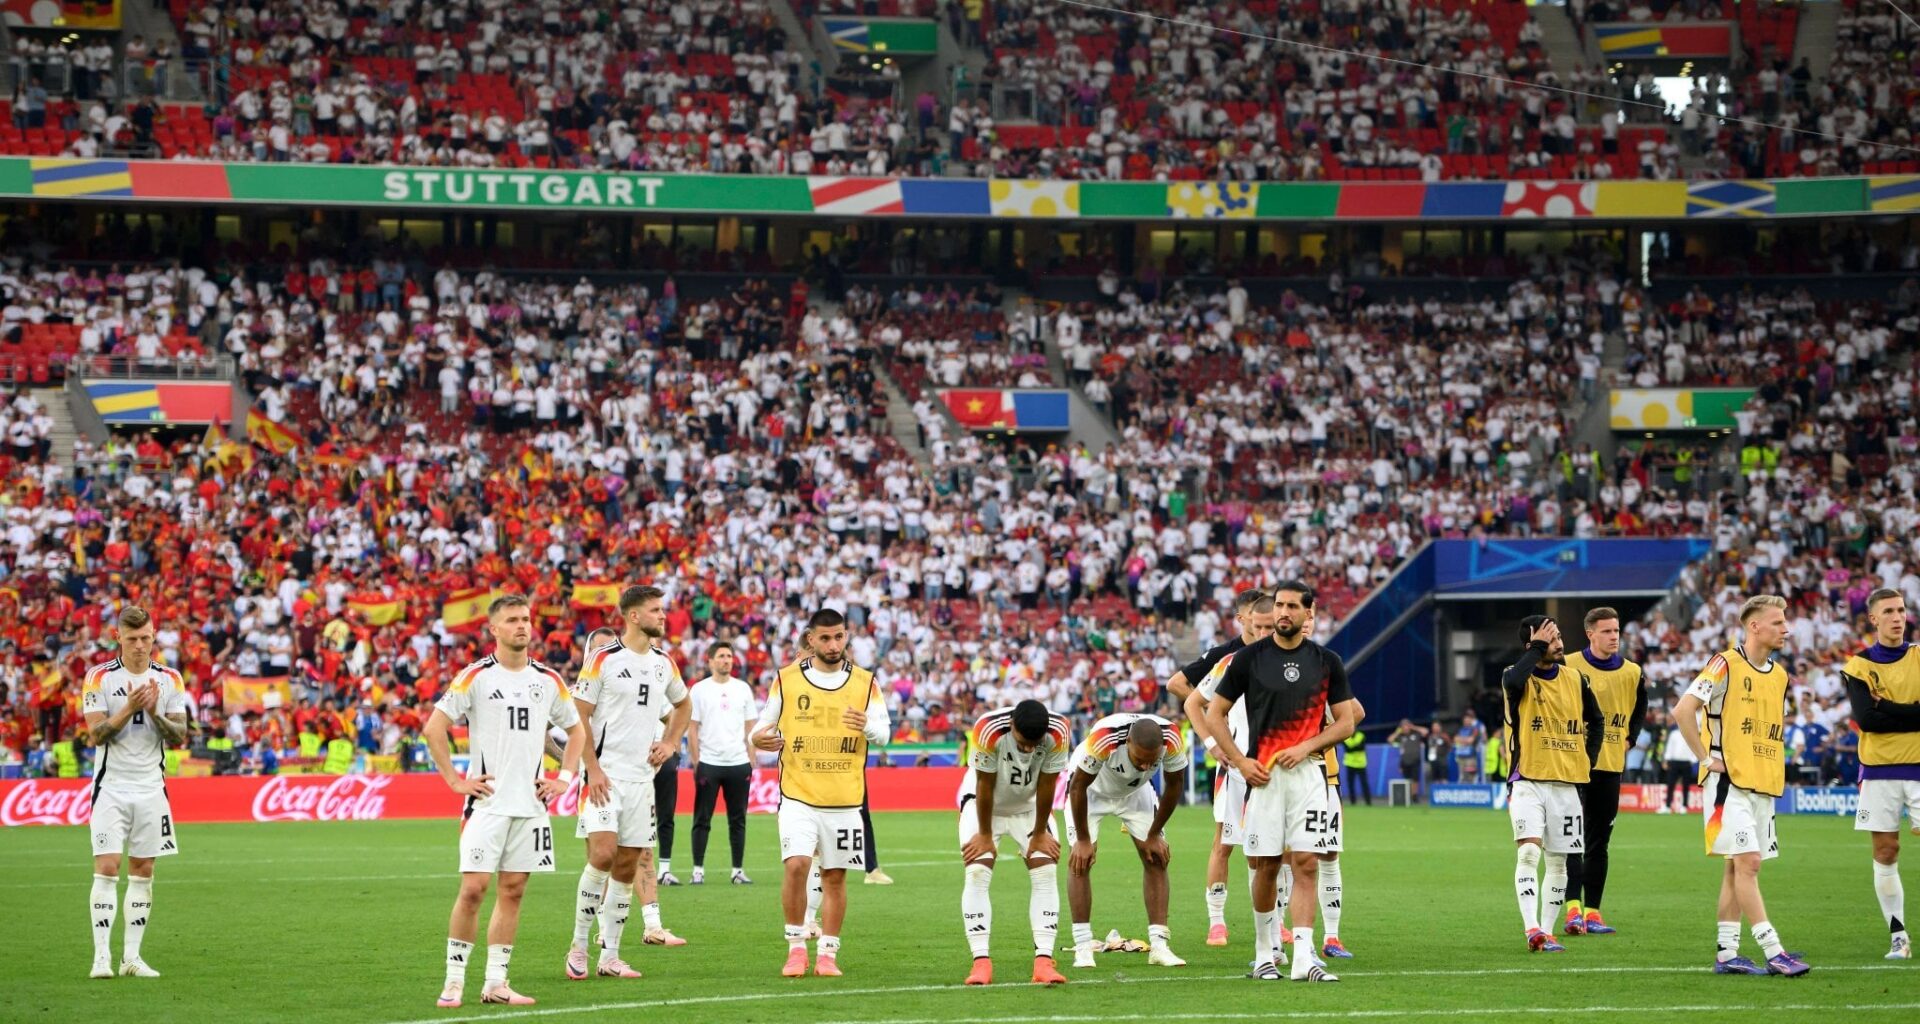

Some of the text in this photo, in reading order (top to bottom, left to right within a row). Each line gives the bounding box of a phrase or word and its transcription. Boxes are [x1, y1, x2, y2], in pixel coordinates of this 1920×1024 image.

[384, 173, 664, 205] STUTTGART
[637, 683, 649, 706] 9
[507, 706, 529, 731] 18
[1552, 741, 1578, 750] RSPECT
[1753, 744, 1776, 757] REECT
[815, 761, 852, 770] RESPECT
[1010, 766, 1032, 786] 20
[1, 779, 92, 826] Coca-C
[252, 774, 393, 821] Coca-Cola
[1797, 788, 1859, 816] Booking.co
[161, 815, 171, 837] 8
[1563, 815, 1581, 836] 21
[532, 827, 551, 851] 18
[837, 829, 863, 851] 26
[581, 890, 600, 900] DFB
